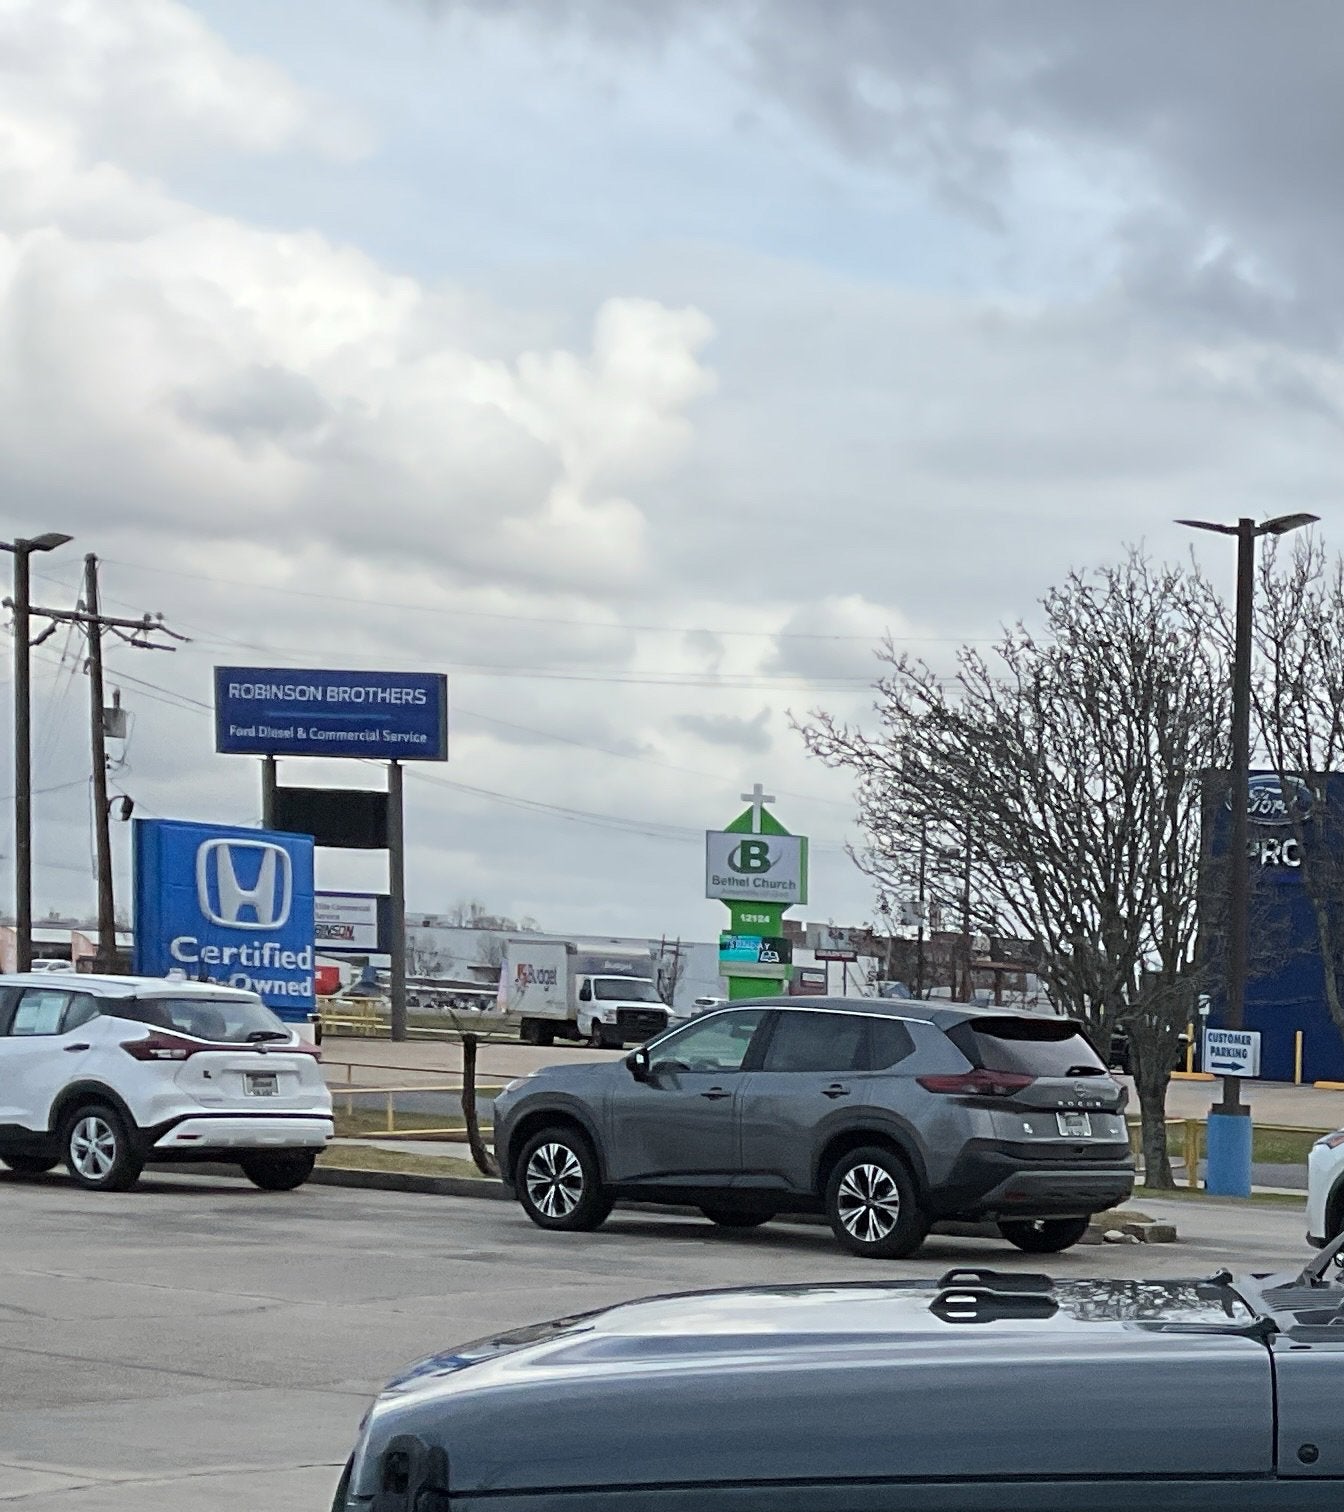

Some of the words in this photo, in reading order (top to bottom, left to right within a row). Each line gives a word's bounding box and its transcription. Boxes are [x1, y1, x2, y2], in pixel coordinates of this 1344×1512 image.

[228, 683, 322, 702] ROBINSON
[326, 686, 427, 705] BROTHERS
[229, 725, 255, 737] Ford
[309, 728, 379, 742] Commercial
[383, 730, 427, 743] Service
[711, 875, 750, 888] Bethel
[752, 877, 797, 890] Church
[170, 936, 312, 971] Certified
[1207, 1032, 1252, 1046] CUSTOMER
[1210, 1045, 1248, 1059] PARKING
